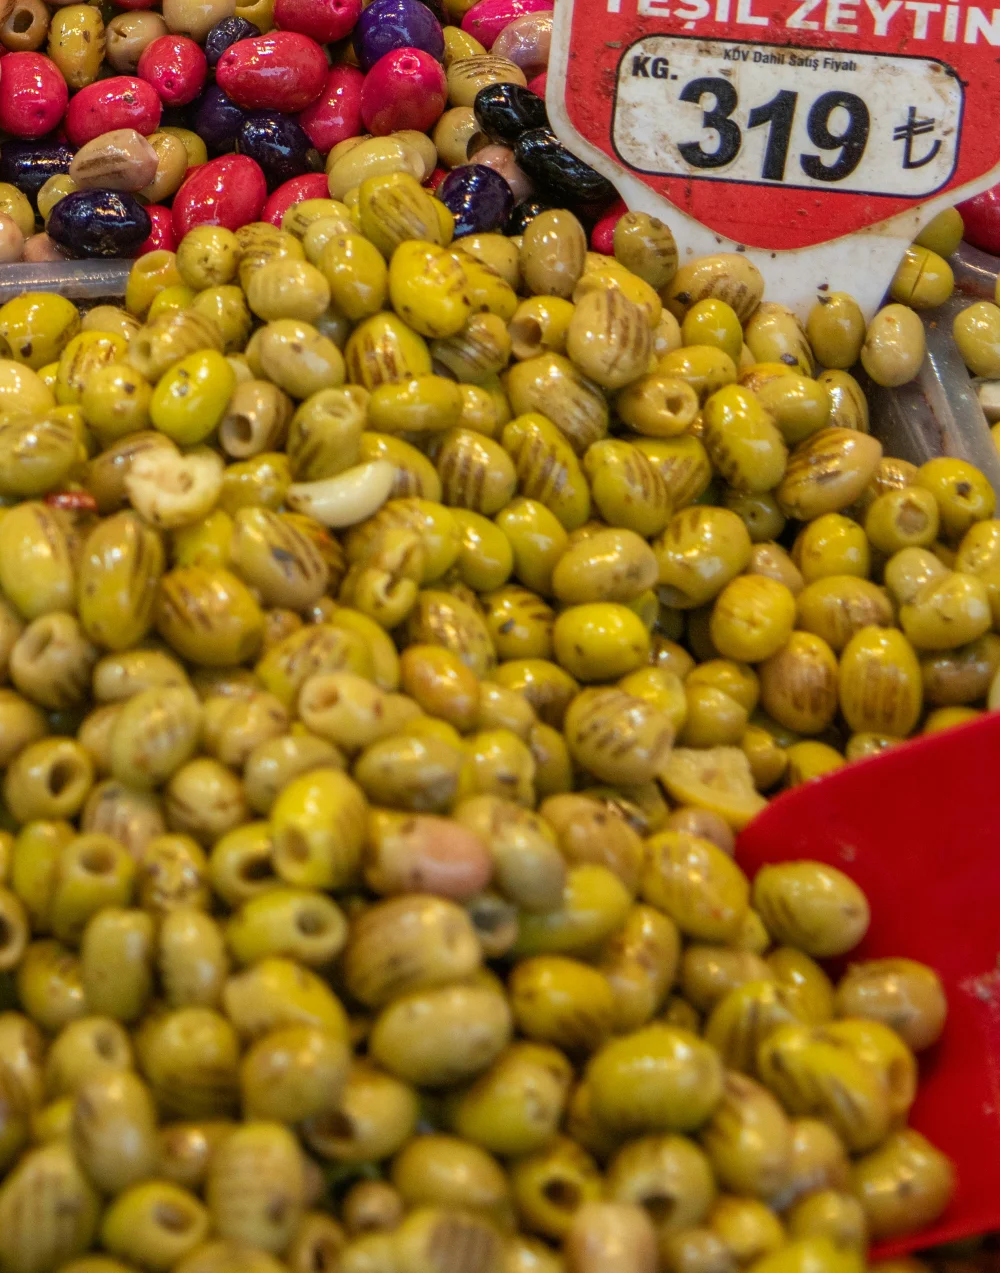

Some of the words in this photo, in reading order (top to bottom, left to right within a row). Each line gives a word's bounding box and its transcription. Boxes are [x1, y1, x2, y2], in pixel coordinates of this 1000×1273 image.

[631, 56, 678, 80] KG.
[723, 48, 749, 62] KDV
[753, 51, 785, 66] Dahil
[788, 54, 819, 71] Satış
[823, 57, 857, 72] Fiyatı
[677, 77, 871, 182] 319
